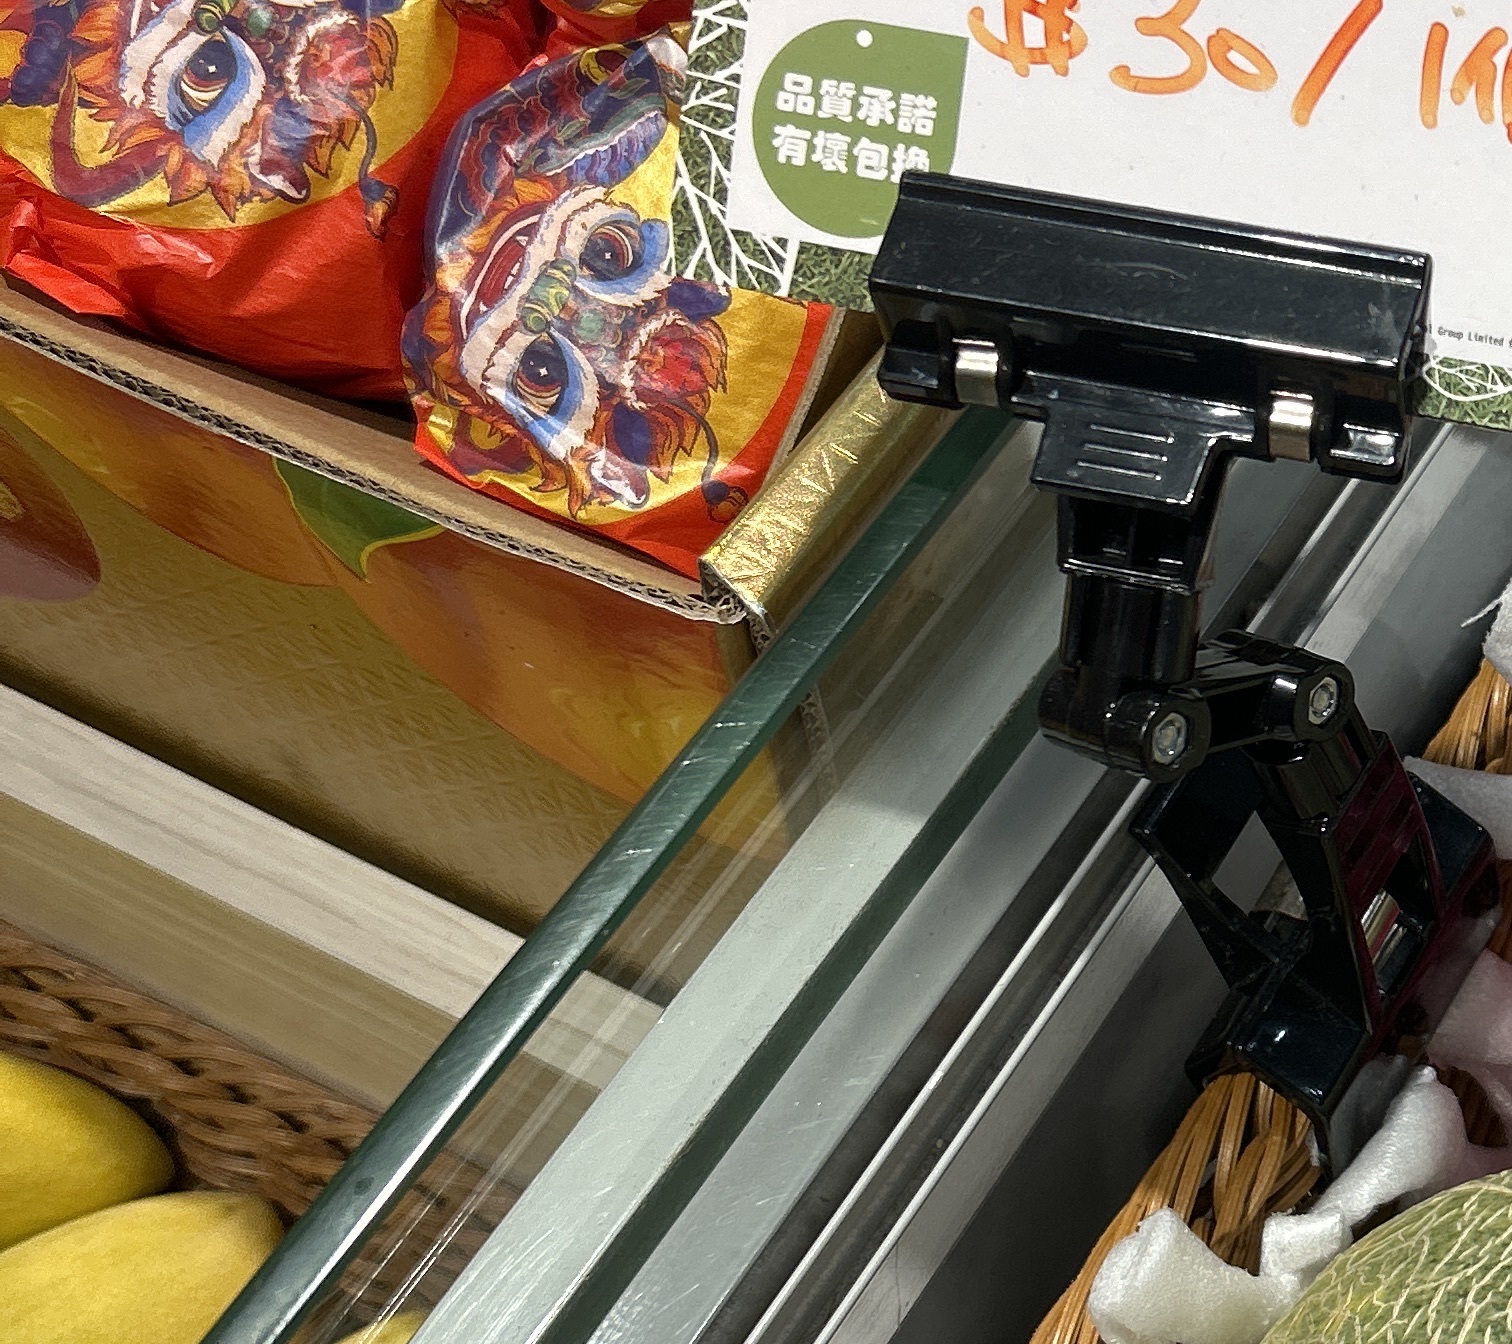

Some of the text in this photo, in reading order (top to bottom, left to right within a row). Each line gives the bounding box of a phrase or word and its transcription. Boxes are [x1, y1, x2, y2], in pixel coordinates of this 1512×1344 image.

[776, 72, 938, 137] 品質承諾
[1438, 326, 1464, 340] Group
[1468, 331, 1505, 348] Limited
